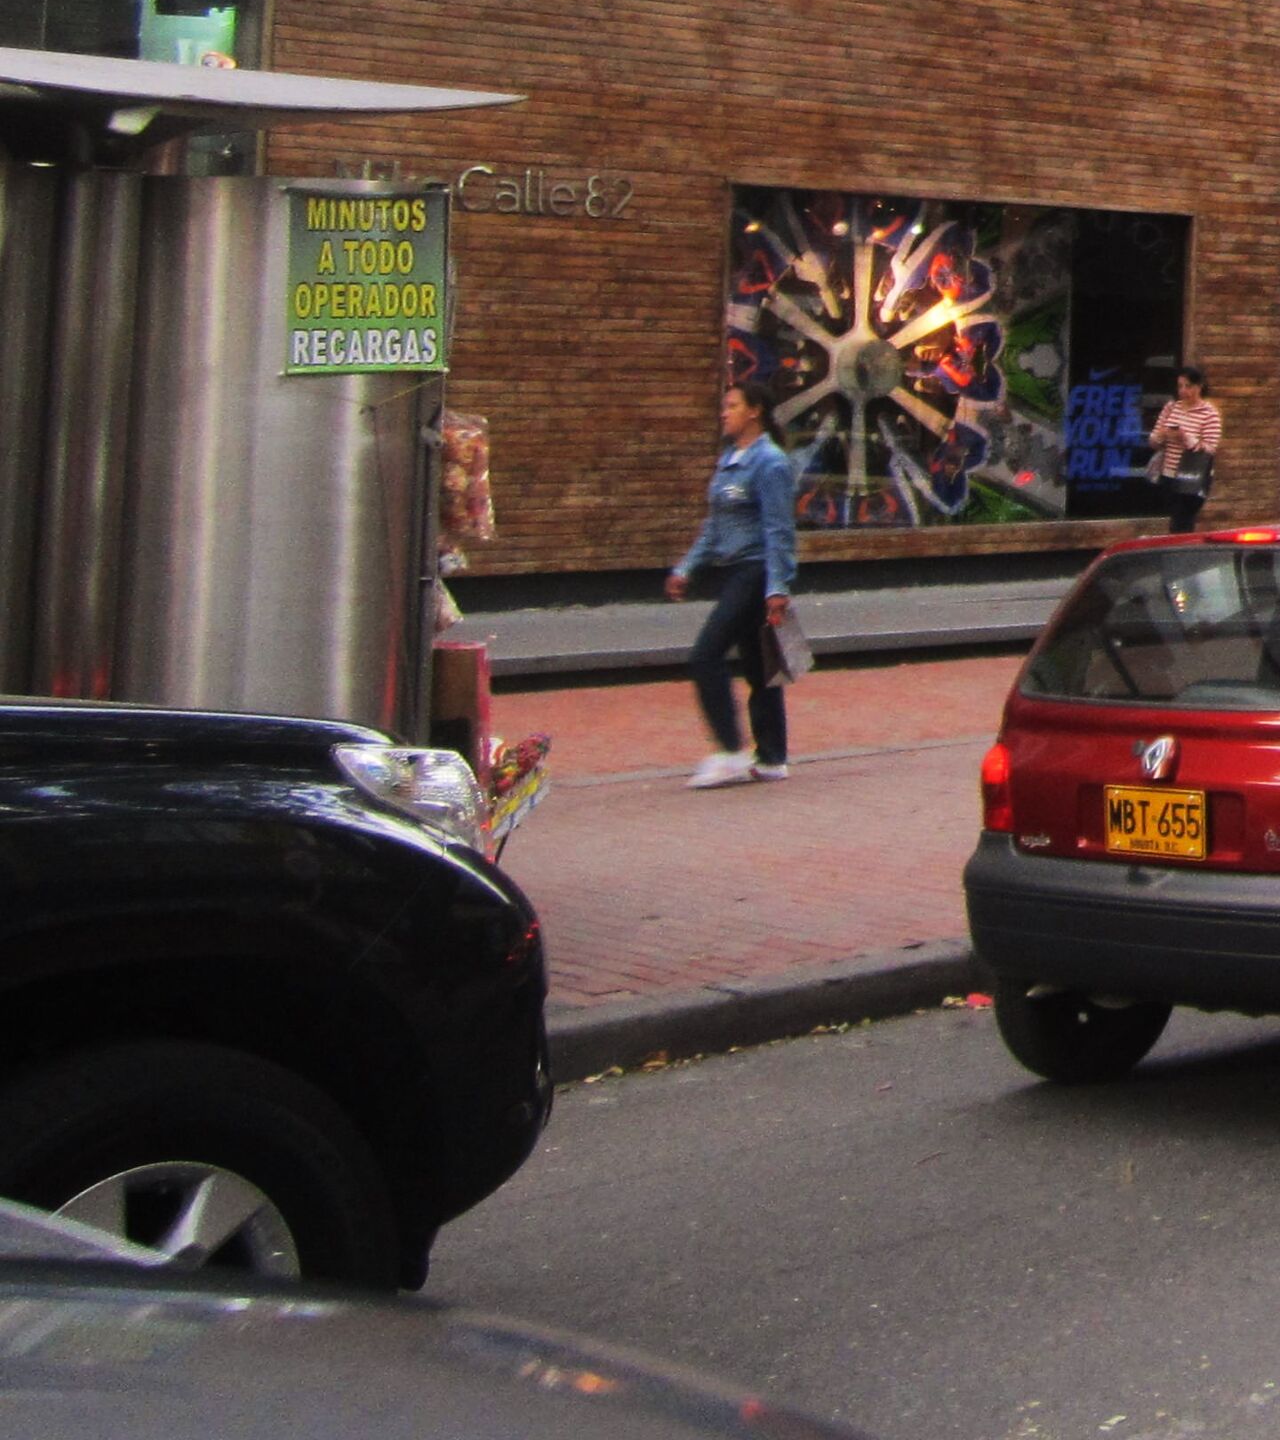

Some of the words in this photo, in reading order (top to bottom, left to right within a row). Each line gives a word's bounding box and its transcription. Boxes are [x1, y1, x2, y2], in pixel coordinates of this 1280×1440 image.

[458, 165, 576, 215] Calle
[585, 174, 634, 219] 82
[307, 198, 427, 232] MINUTOS
[317, 240, 335, 275] A
[343, 240, 414, 274] TODO
[295, 282, 436, 319] OPERADOR
[292, 329, 437, 365] RECARGAS
[1069, 384, 1142, 417] FREE
[1064, 415, 1142, 447] YOUR
[1068, 448, 1132, 479] RUN
[1109, 799, 1151, 835] MBT
[1158, 803, 1200, 839] 655
